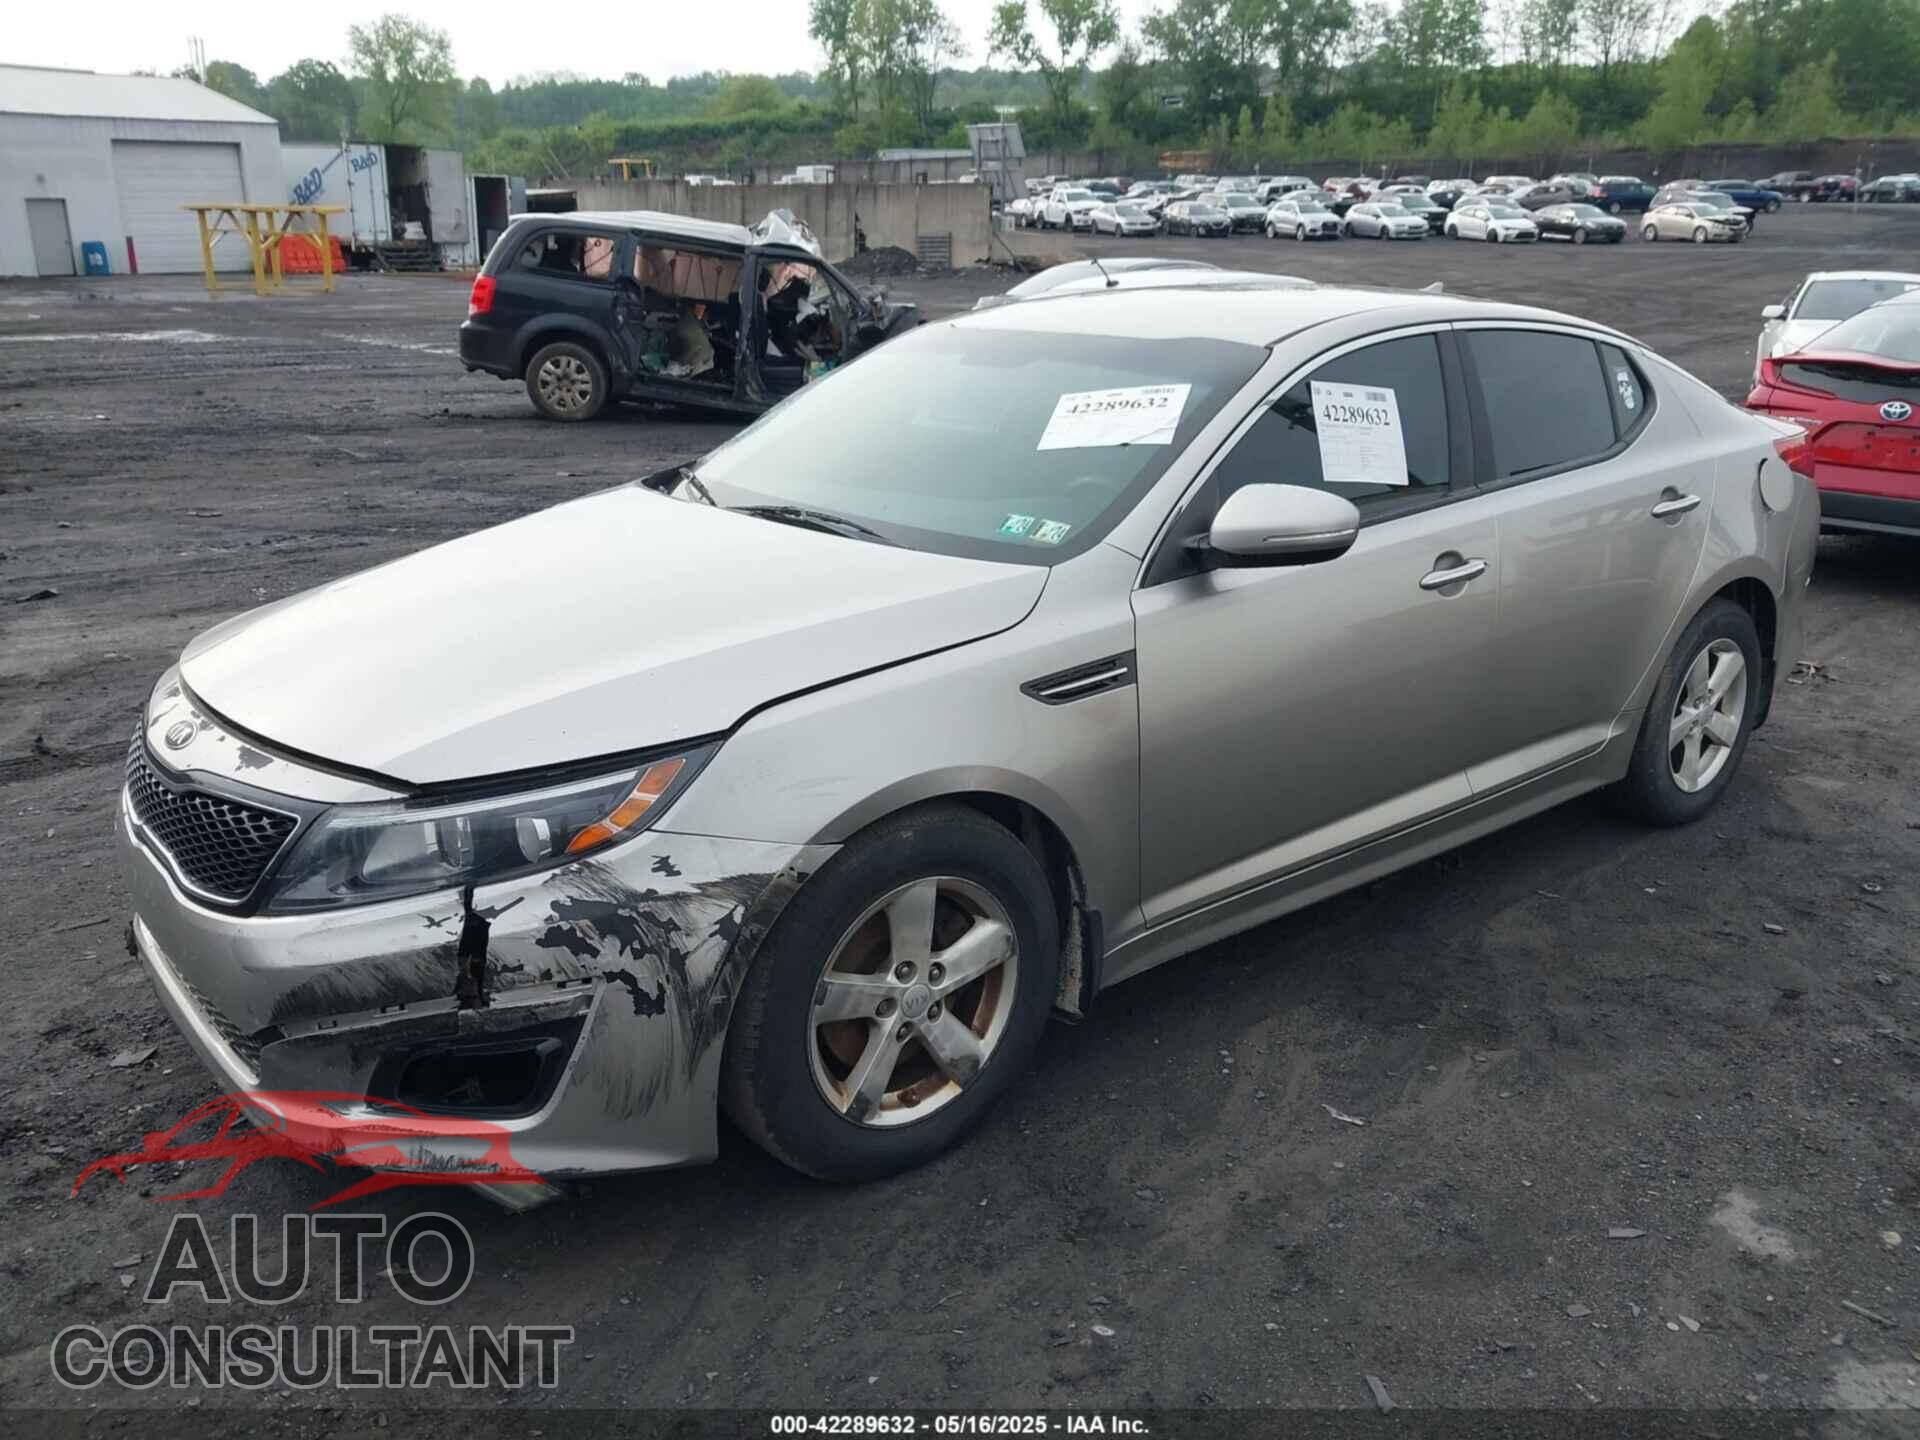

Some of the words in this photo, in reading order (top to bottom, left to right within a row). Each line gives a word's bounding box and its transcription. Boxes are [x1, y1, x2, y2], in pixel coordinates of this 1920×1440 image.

[294, 168, 322, 205] R&D
[1065, 396, 1169, 414] 42289632
[1323, 403, 1391, 426] 42289632
